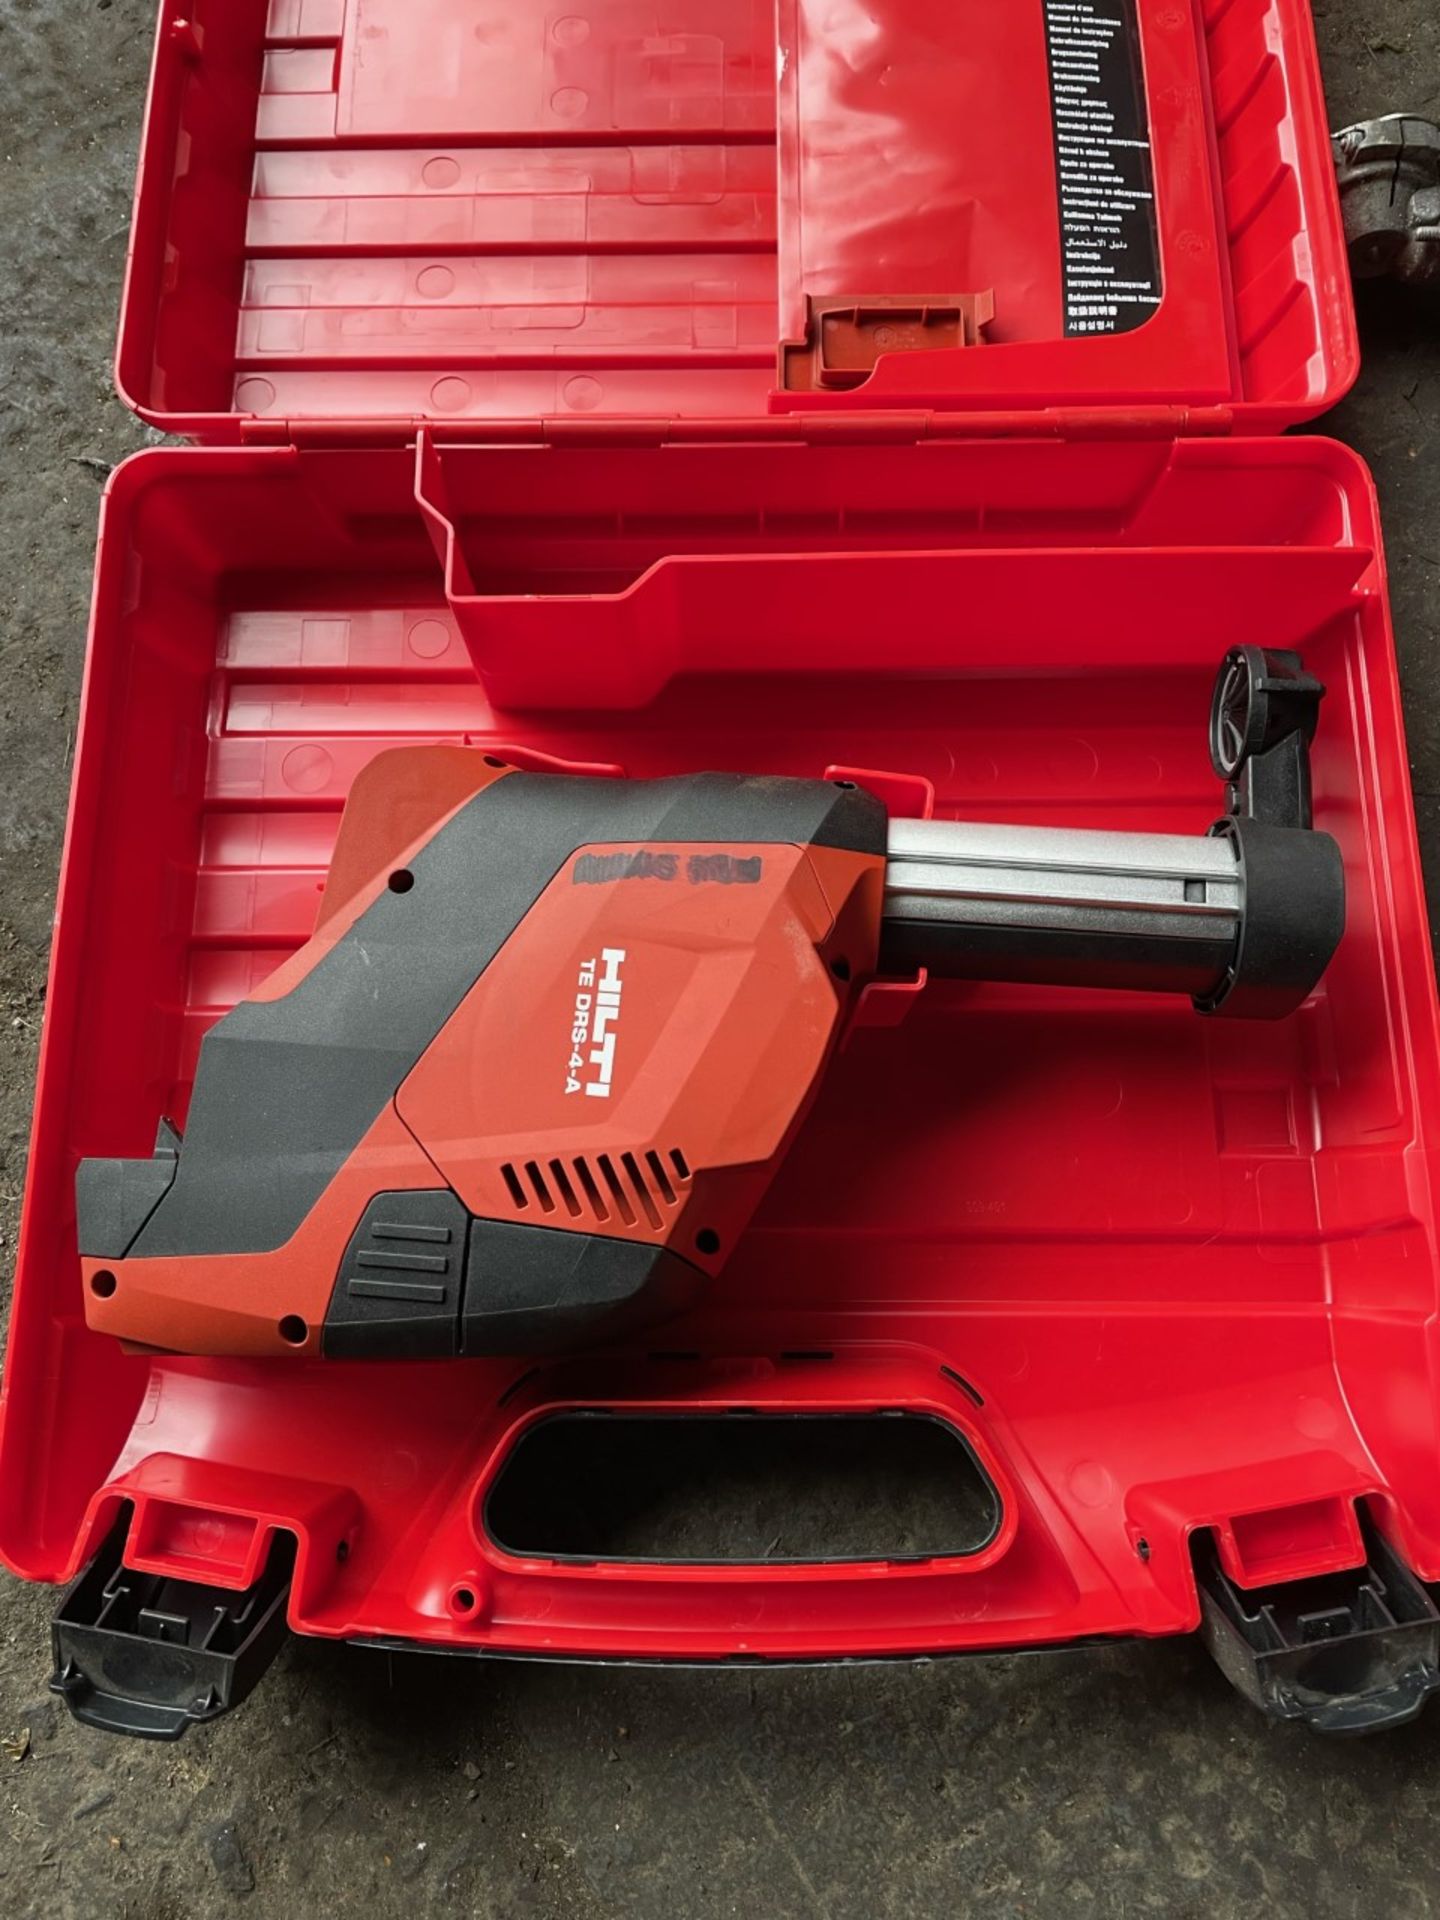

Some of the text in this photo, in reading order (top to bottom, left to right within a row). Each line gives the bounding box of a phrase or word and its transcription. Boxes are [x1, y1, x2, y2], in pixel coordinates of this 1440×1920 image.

[564, 958, 596, 1095] TE DRS-4-A
[585, 947, 626, 1097] HILTI
